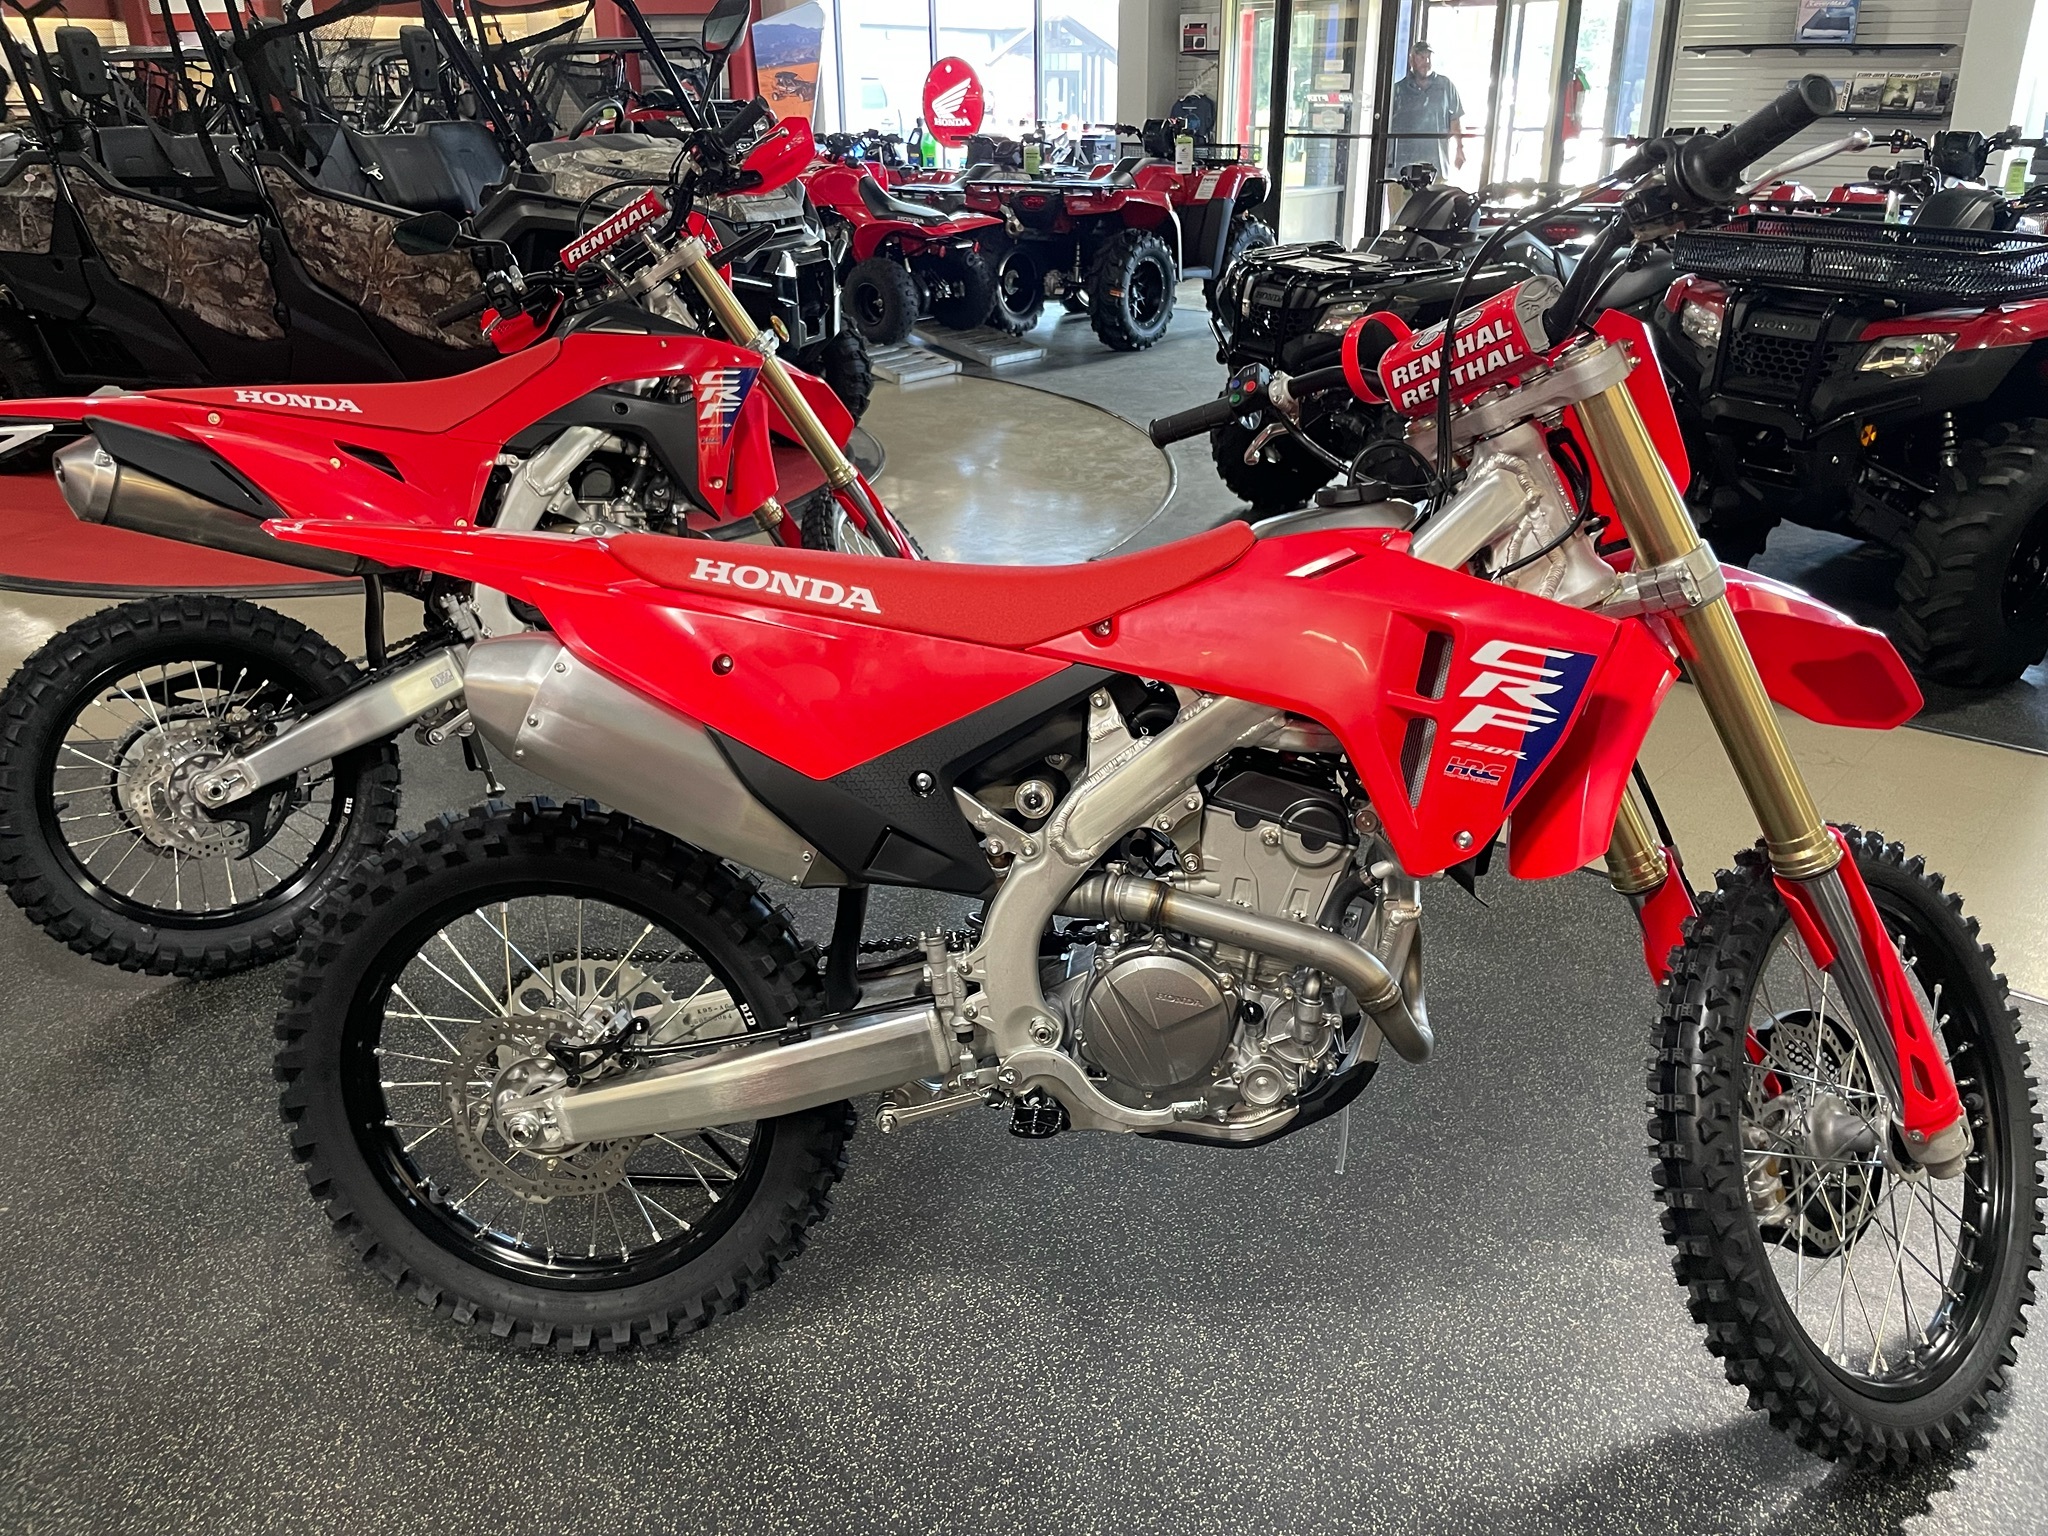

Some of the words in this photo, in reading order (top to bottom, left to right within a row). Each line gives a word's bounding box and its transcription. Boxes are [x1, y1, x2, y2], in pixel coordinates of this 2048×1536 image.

[934, 117, 972, 127] HONDA
[897, 215, 925, 224] HONDA
[567, 203, 654, 264] RENTHAL
[1391, 319, 1513, 389] RENHAL
[234, 390, 363, 413] HONDA
[699, 370, 743, 420] CRF
[690, 557, 882, 614] HONDA
[1450, 639, 1575, 733] CRF
[1450, 739, 1528, 761] 250R
[1444, 756, 1507, 782] HRC
[1155, 992, 1205, 1008] HONDA
[739, 1003, 757, 1026] DID
